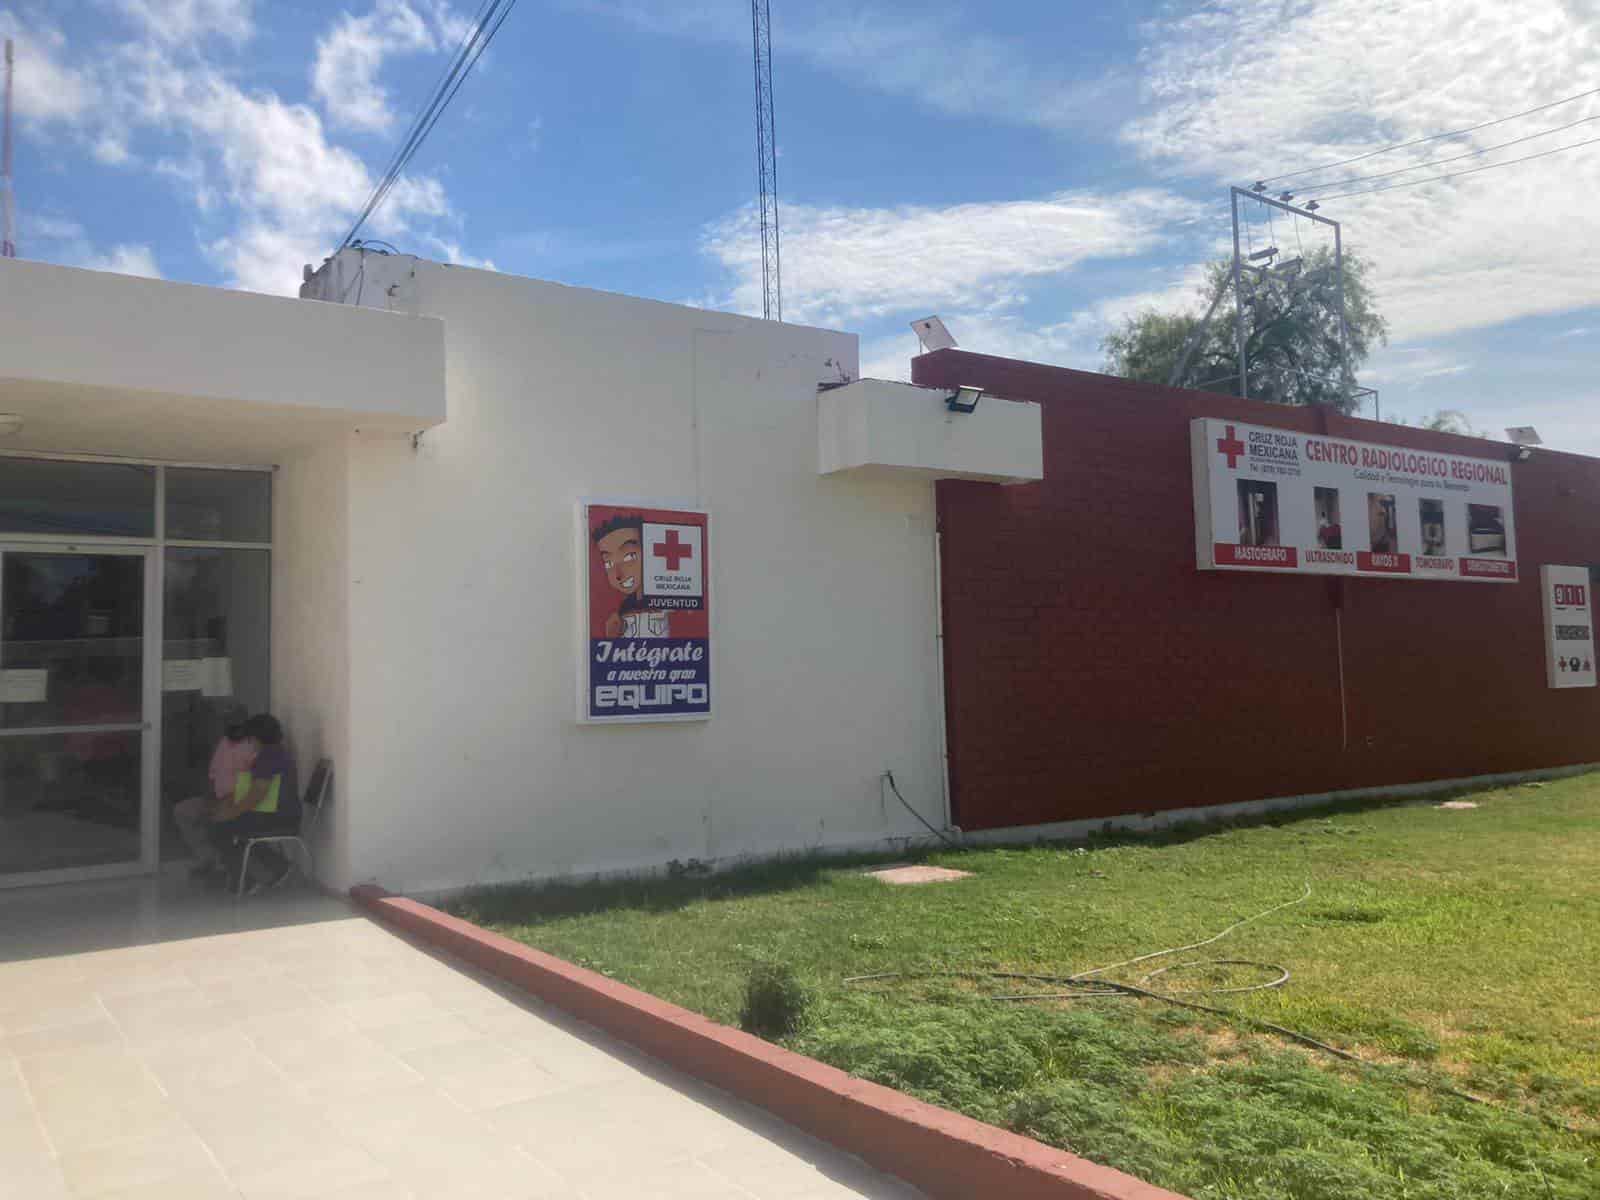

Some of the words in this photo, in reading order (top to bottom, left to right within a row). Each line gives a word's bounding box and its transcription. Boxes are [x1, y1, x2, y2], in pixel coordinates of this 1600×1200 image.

[1249, 431, 1273, 445] CRUZ
[1274, 434, 1298, 448] ROJA
[1249, 444, 1298, 460] MEXICANA
[1305, 439, 1358, 466] CENTRO
[1362, 448, 1447, 478] RADIOLOGICO
[1451, 460, 1508, 485] REGIONAL
[1234, 546, 1287, 561] MASTOGRAFO
[1555, 586, 1584, 604] 911
[648, 599, 698, 608] JUVENTUD
[596, 640, 704, 667] Intégrate
[607, 670, 617, 681] a
[618, 668, 666, 681] nuestro
[668, 669, 697, 682] gran
